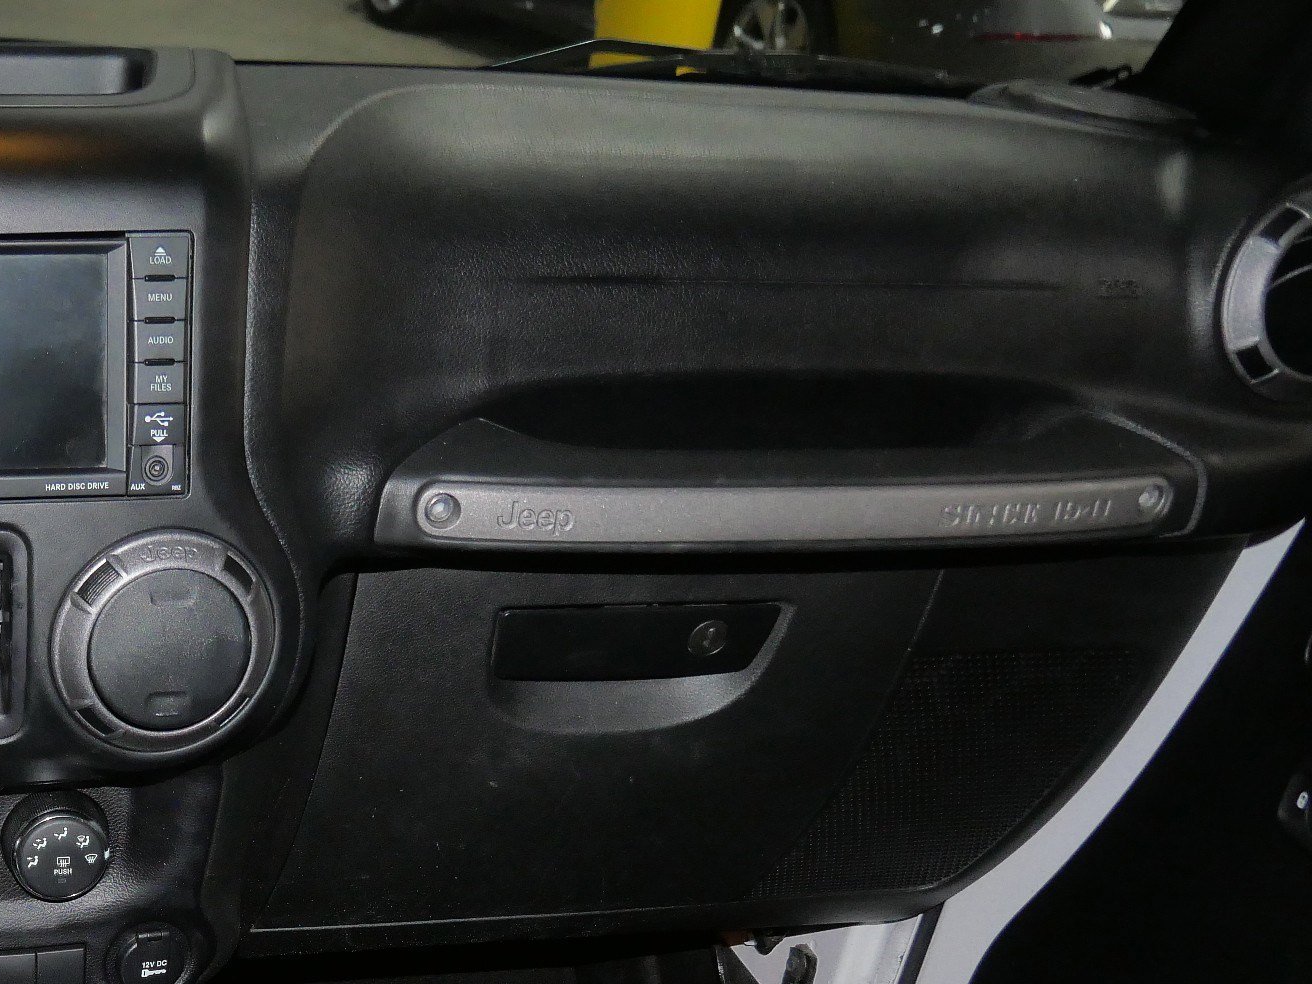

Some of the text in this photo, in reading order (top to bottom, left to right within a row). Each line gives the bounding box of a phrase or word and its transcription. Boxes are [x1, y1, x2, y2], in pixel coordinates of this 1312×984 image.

[149, 256, 172, 264] LOAD
[148, 293, 173, 302] MENU
[148, 336, 173, 344] AUDIO
[155, 375, 167, 383] MY
[150, 383, 172, 391] FILES
[150, 429, 168, 437] PULL
[45, 481, 109, 491] HARD DISC DRIVE
[496, 500, 575, 536] Jeep
[54, 867, 73, 876] PUSH
[156, 959, 168, 967] DC
